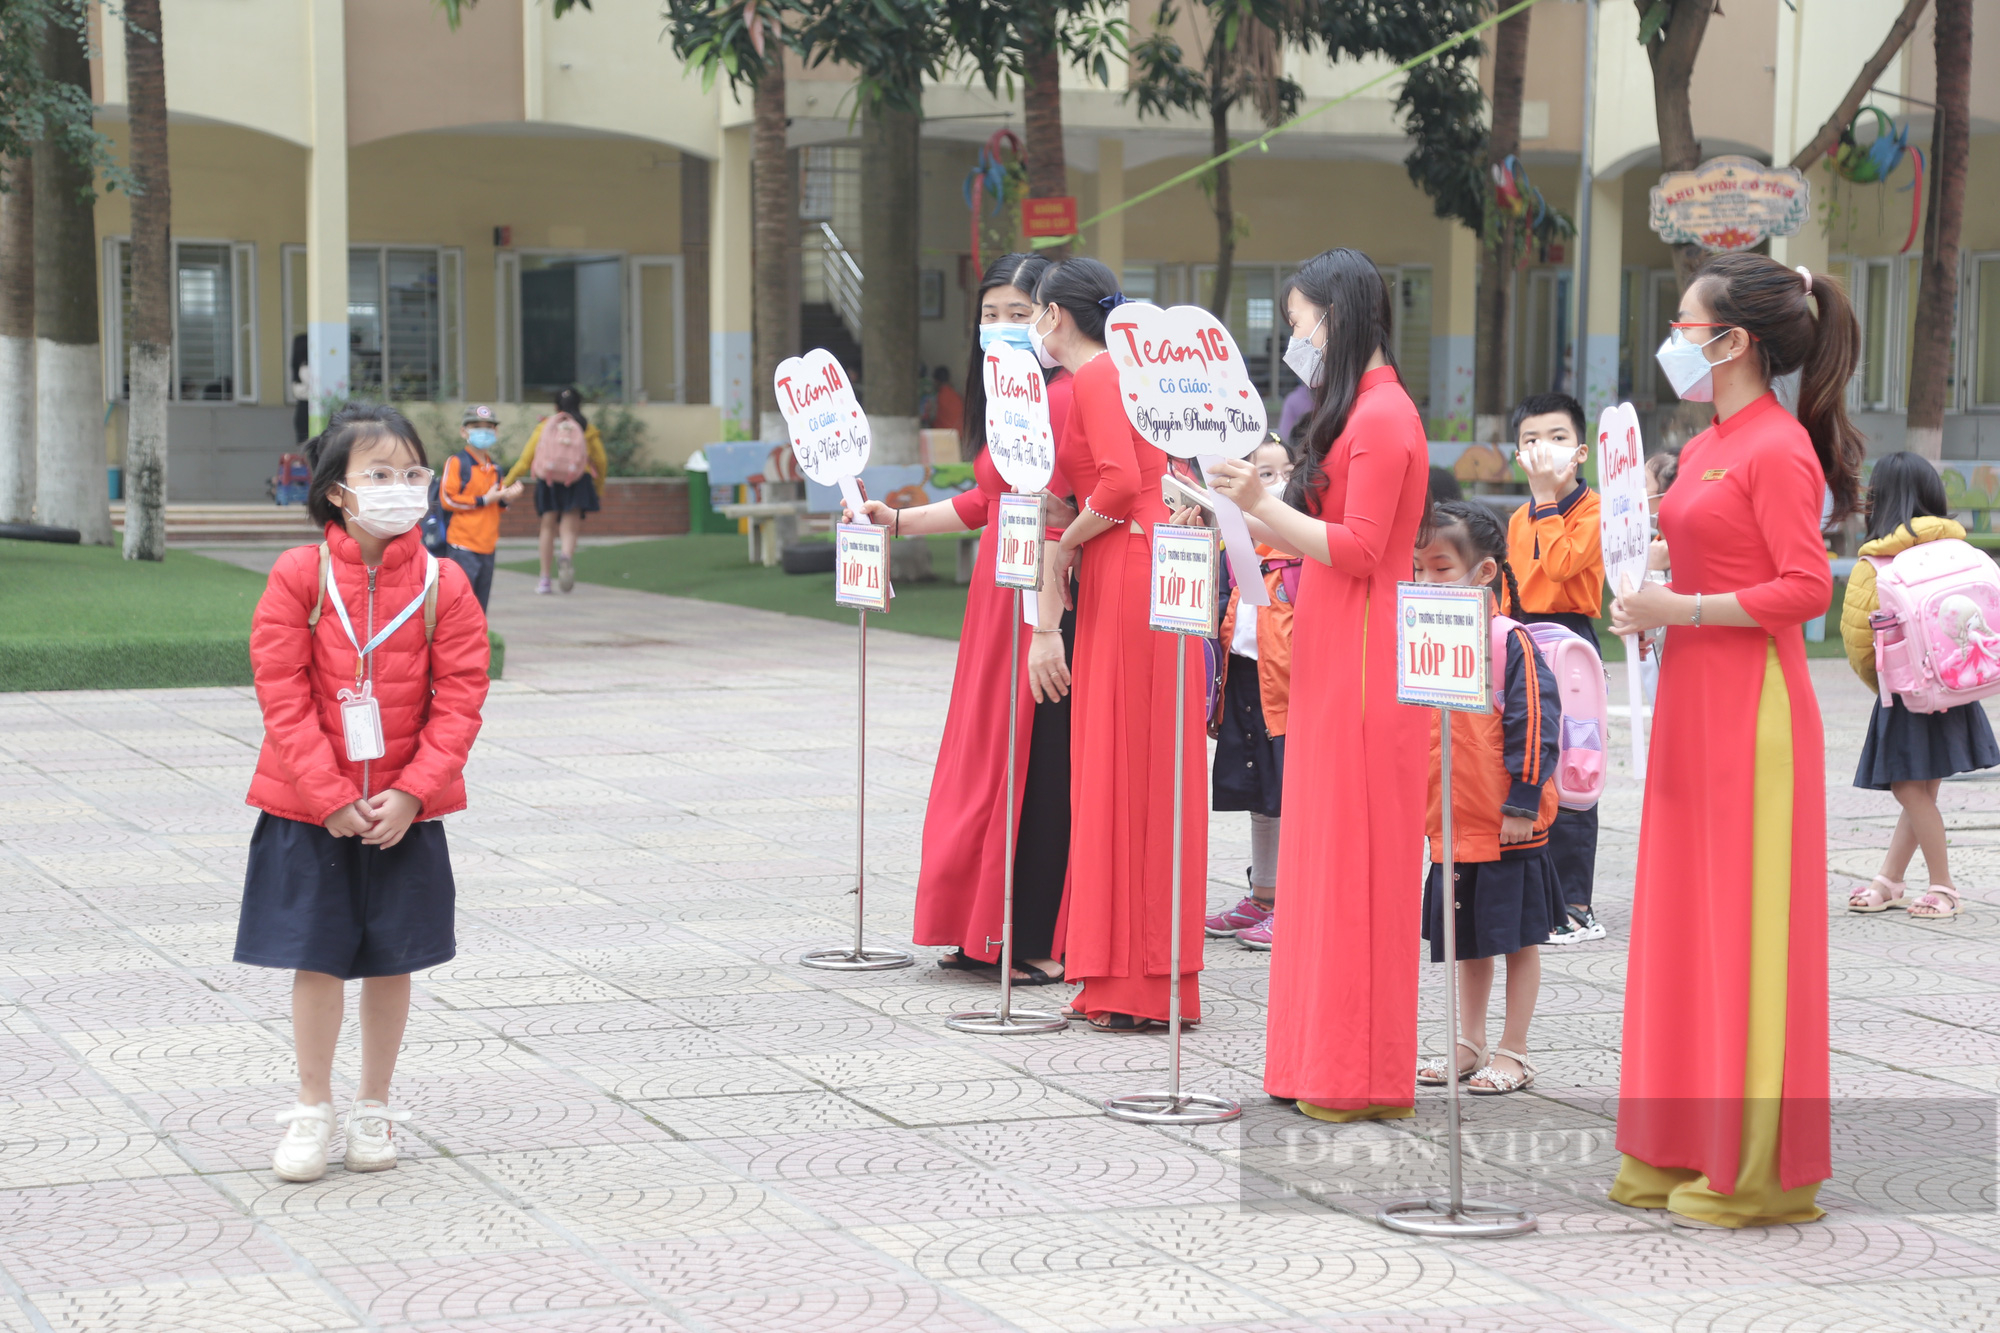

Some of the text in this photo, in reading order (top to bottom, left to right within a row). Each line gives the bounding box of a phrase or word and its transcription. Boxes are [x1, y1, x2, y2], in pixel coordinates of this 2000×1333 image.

[1110, 322, 1229, 376] Team1C
[1159, 377, 1213, 394] Cô Giáo:
[809, 411, 838, 432] Cô Giáo:
[1005, 410, 1030, 430] Cô Giáo:
[1137, 406, 1261, 442] Nguyễn Phương Thảo
[800, 425, 868, 475] Lý Việt Nga
[1002, 529, 1035, 566] LỚP 1B
[843, 555, 879, 589] LỚP 1A
[1159, 566, 1206, 609] LỚP 1C
[1408, 631, 1475, 679] LỚP 1D
